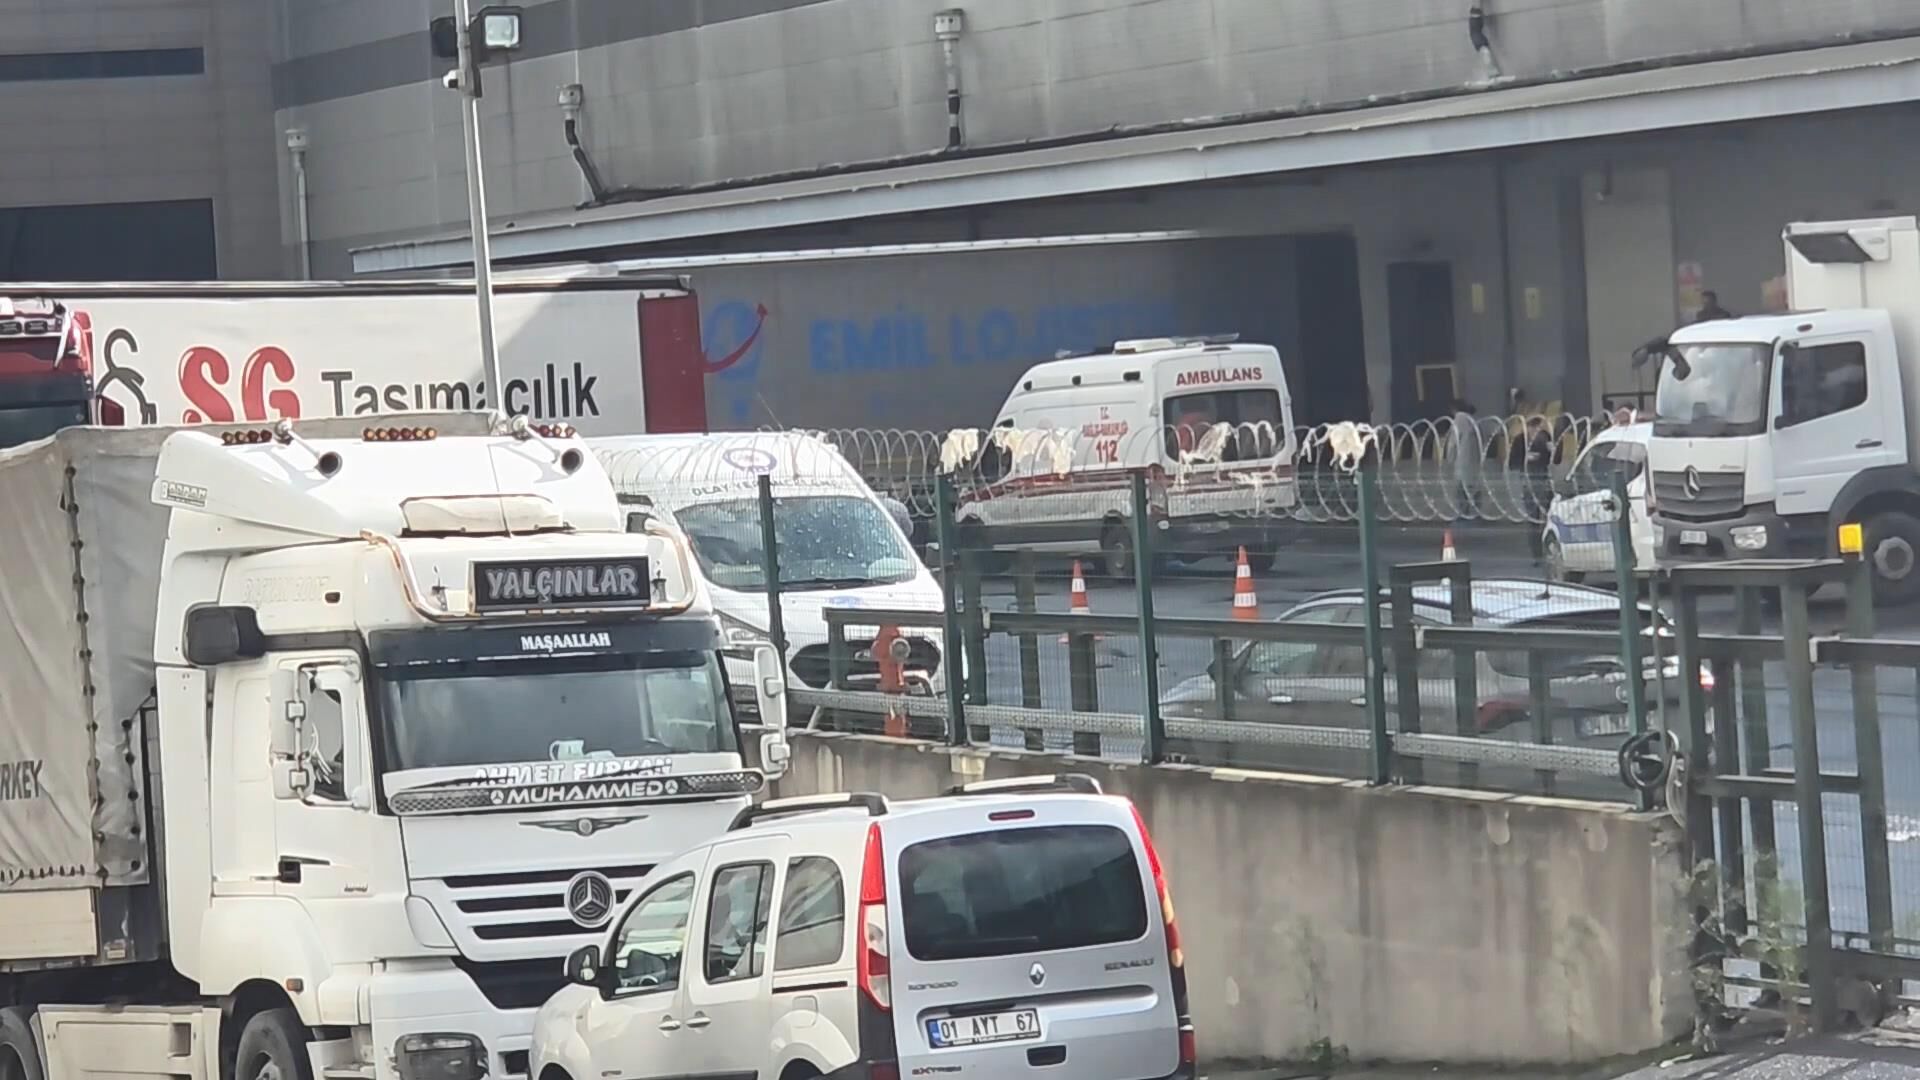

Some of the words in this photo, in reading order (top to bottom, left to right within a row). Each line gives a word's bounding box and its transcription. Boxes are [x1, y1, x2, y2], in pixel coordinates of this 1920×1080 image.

[178, 346, 300, 423] SG
[1176, 367, 1262, 386] AMBULANS
[1096, 440, 1118, 463] 112
[486, 566, 638, 602] YALÇINLAR
[521, 633, 611, 653] MAŞAALLAH
[471, 764, 565, 787] AHMET
[507, 780, 664, 804] MUHAMMED
[941, 1021, 958, 1039] 01
[972, 1015, 998, 1035] AYT
[1016, 1013, 1033, 1032] 67
